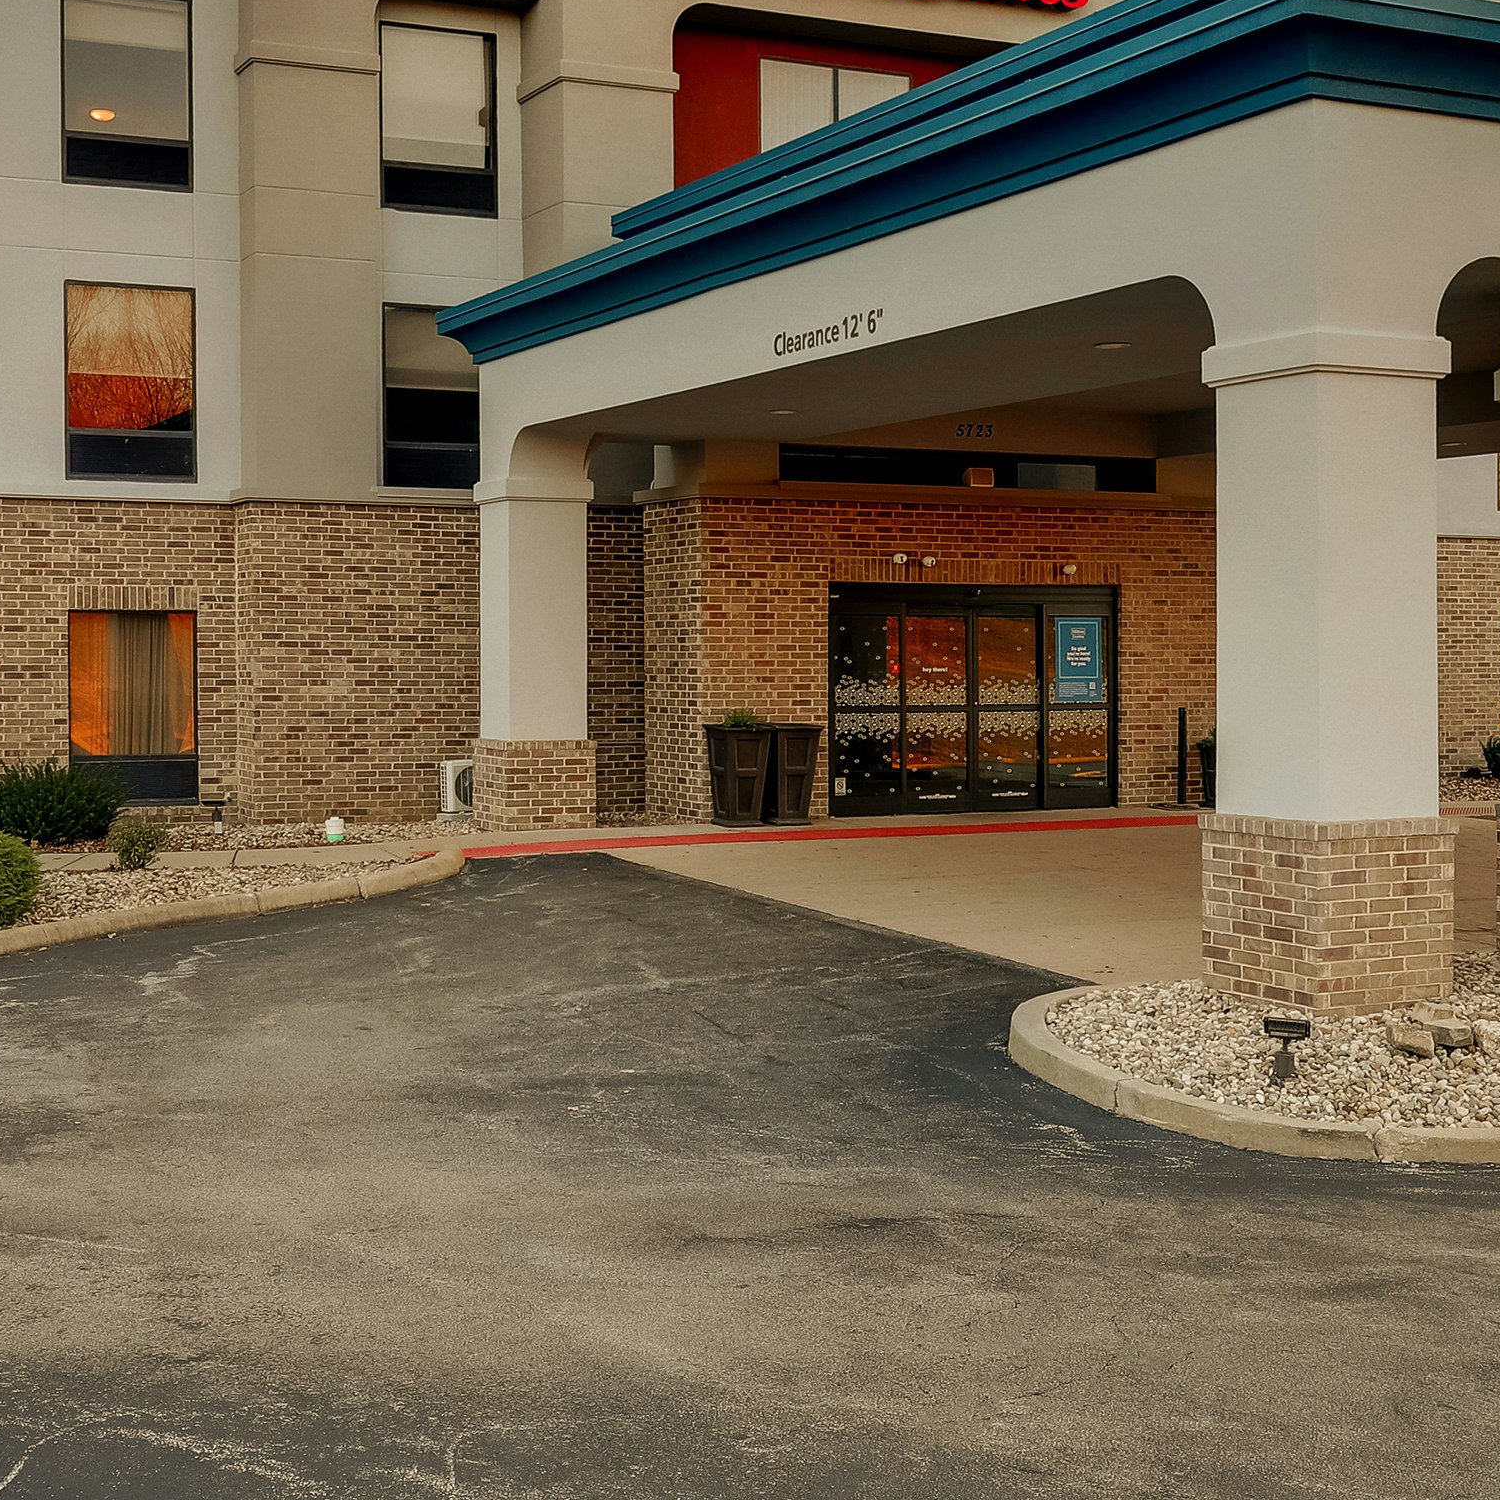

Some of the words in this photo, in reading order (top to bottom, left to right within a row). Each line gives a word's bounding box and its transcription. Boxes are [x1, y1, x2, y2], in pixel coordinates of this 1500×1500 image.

[774, 324, 840, 356] Clearance
[842, 313, 863, 340] 12'
[867, 308, 884, 334] 6"
[956, 423, 993, 437] 5723
